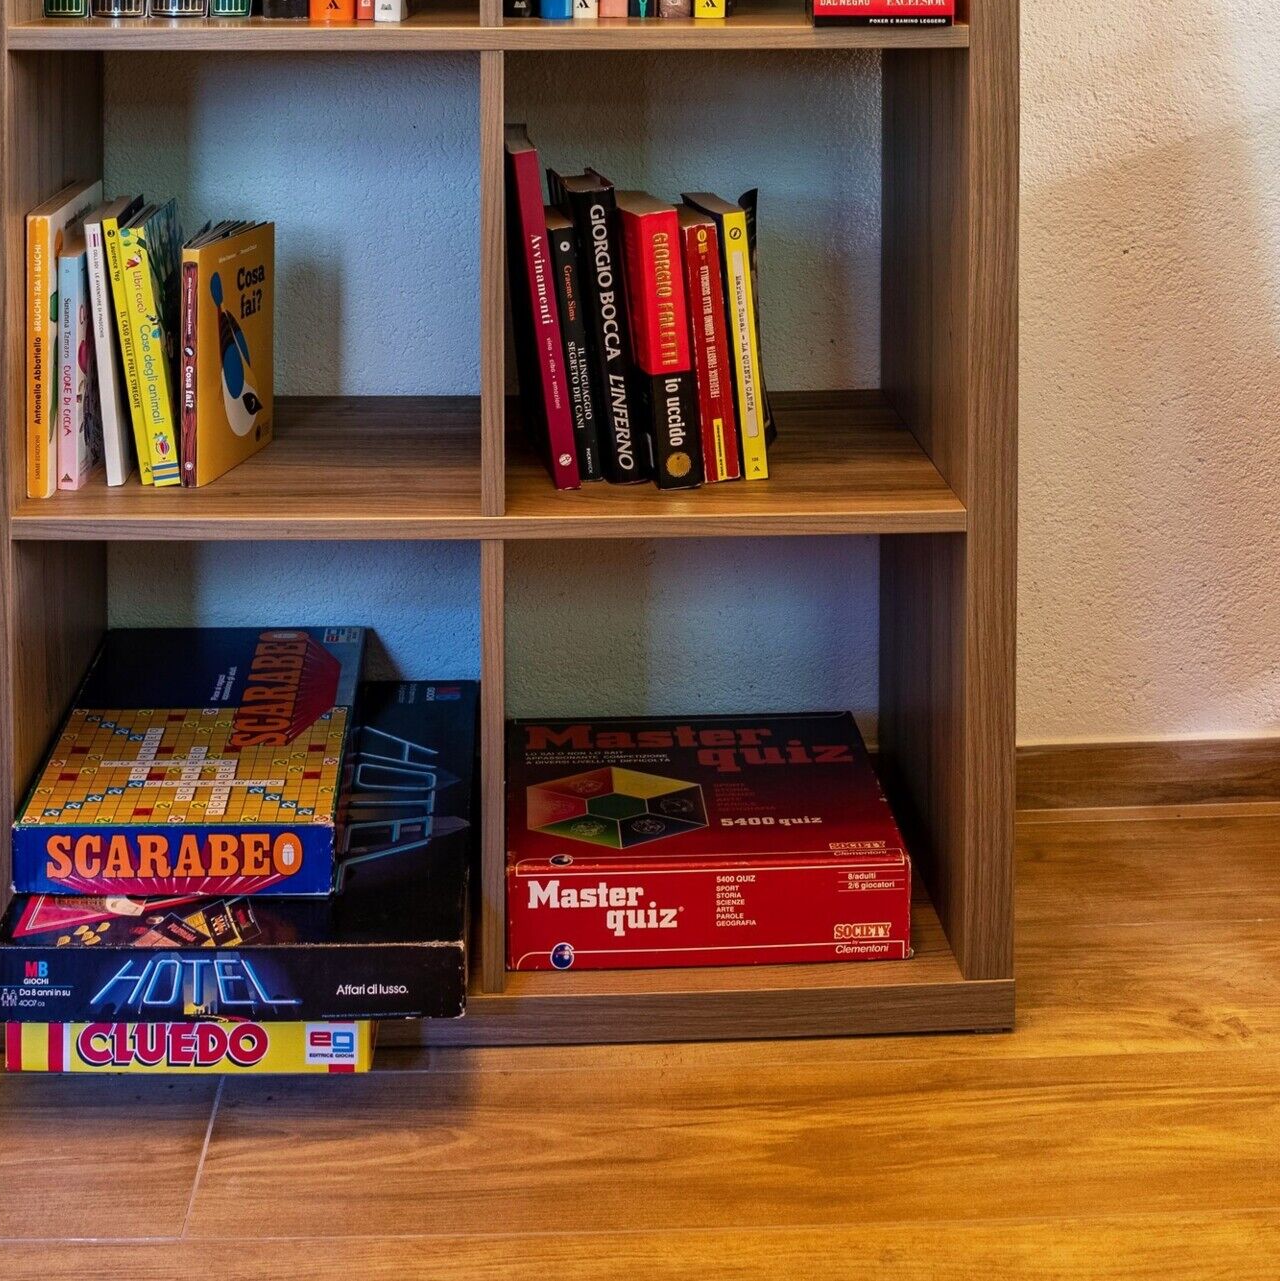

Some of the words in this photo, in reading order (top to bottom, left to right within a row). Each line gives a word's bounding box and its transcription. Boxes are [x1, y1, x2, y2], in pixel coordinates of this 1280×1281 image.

[33, 244, 42, 272] BUCHI
[110, 241, 119, 270] Laurence
[590, 204, 613, 288] GIORGIO
[114, 270, 122, 282] Yep
[237, 264, 266, 292] Cosa
[652, 232, 673, 298] GIORGIO
[33, 279, 41, 297] TRA
[132, 270, 144, 291] Libri
[530, 234, 554, 325] Avvinamenti
[563, 264, 574, 299] Graeme
[735, 274, 745, 306] Markus
[33, 298, 42, 332] BRUCHI
[64, 298, 72, 328] Susanna
[120, 310, 127, 318] IL
[136, 292, 147, 314] cucù
[240, 288, 263, 320] fai?
[567, 299, 577, 321] Sims
[702, 296, 713, 315] DELLO
[121, 319, 130, 336] CASO
[140, 324, 152, 352] Case
[599, 291, 621, 362] BOCCA
[703, 315, 715, 336] GIORNO
[64, 330, 72, 359] Tamaro
[124, 338, 134, 357] DELLE
[577, 347, 586, 358] IL
[740, 342, 749, 353] LA
[33, 337, 42, 381] Abbatiello
[127, 358, 137, 376] PERLE
[143, 354, 158, 382] degli
[549, 358, 557, 373] cibo
[567, 341, 581, 385] SEGRETO
[741, 355, 752, 385] QUINTA
[63, 364, 73, 393] CUORE
[185, 365, 194, 389] Cosa
[578, 358, 593, 420] LINGUAGGIO
[664, 377, 682, 393] io
[33, 383, 42, 425] Antonello
[63, 396, 72, 405] DI
[129, 378, 141, 409] STREGATE
[149, 384, 165, 424] animali
[185, 390, 194, 408] fai?
[552, 381, 562, 409] emozioni
[572, 386, 582, 403] DEI
[745, 386, 755, 413] CARTA
[63, 408, 73, 437] CICCIA
[574, 404, 585, 429] CANI
[608, 373, 635, 470] L'INFERNO
[666, 397, 687, 447] uccido
[586, 447, 594, 474] PICKWICK
[230, 630, 310, 747] SCARABEO
[524, 724, 772, 750] Master
[699, 739, 854, 773] quiz
[334, 725, 439, 895] HOTEL
[721, 816, 776, 827] 5400
[779, 815, 823, 827] quiz
[46, 832, 303, 878] SCARABEO
[829, 841, 886, 850] SOCIETY
[833, 849, 887, 857] Clementoni
[716, 875, 735, 883] 5400
[736, 874, 756, 883] QUIZ
[847, 872, 877, 881] 8/adulti
[847, 881, 860, 889] 2/6
[860, 881, 895, 891] giocatori
[527, 880, 644, 909] Master
[606, 901, 678, 937] quiz
[834, 923, 892, 939] SOCIETY
[835, 944, 889, 954] Clementoni
[24, 961, 49, 978] MB
[89, 959, 304, 1007] HOTEL
[19, 988, 31, 997] Da
[31, 988, 37, 997] 8
[37, 988, 54, 997] anni
[54, 988, 62, 997] in
[336, 983, 366, 996] Affari
[366, 983, 378, 995] di
[378, 983, 409, 995] lusso.
[77, 1021, 270, 1066] CLUEDO
[310, 1031, 354, 1053] eg
